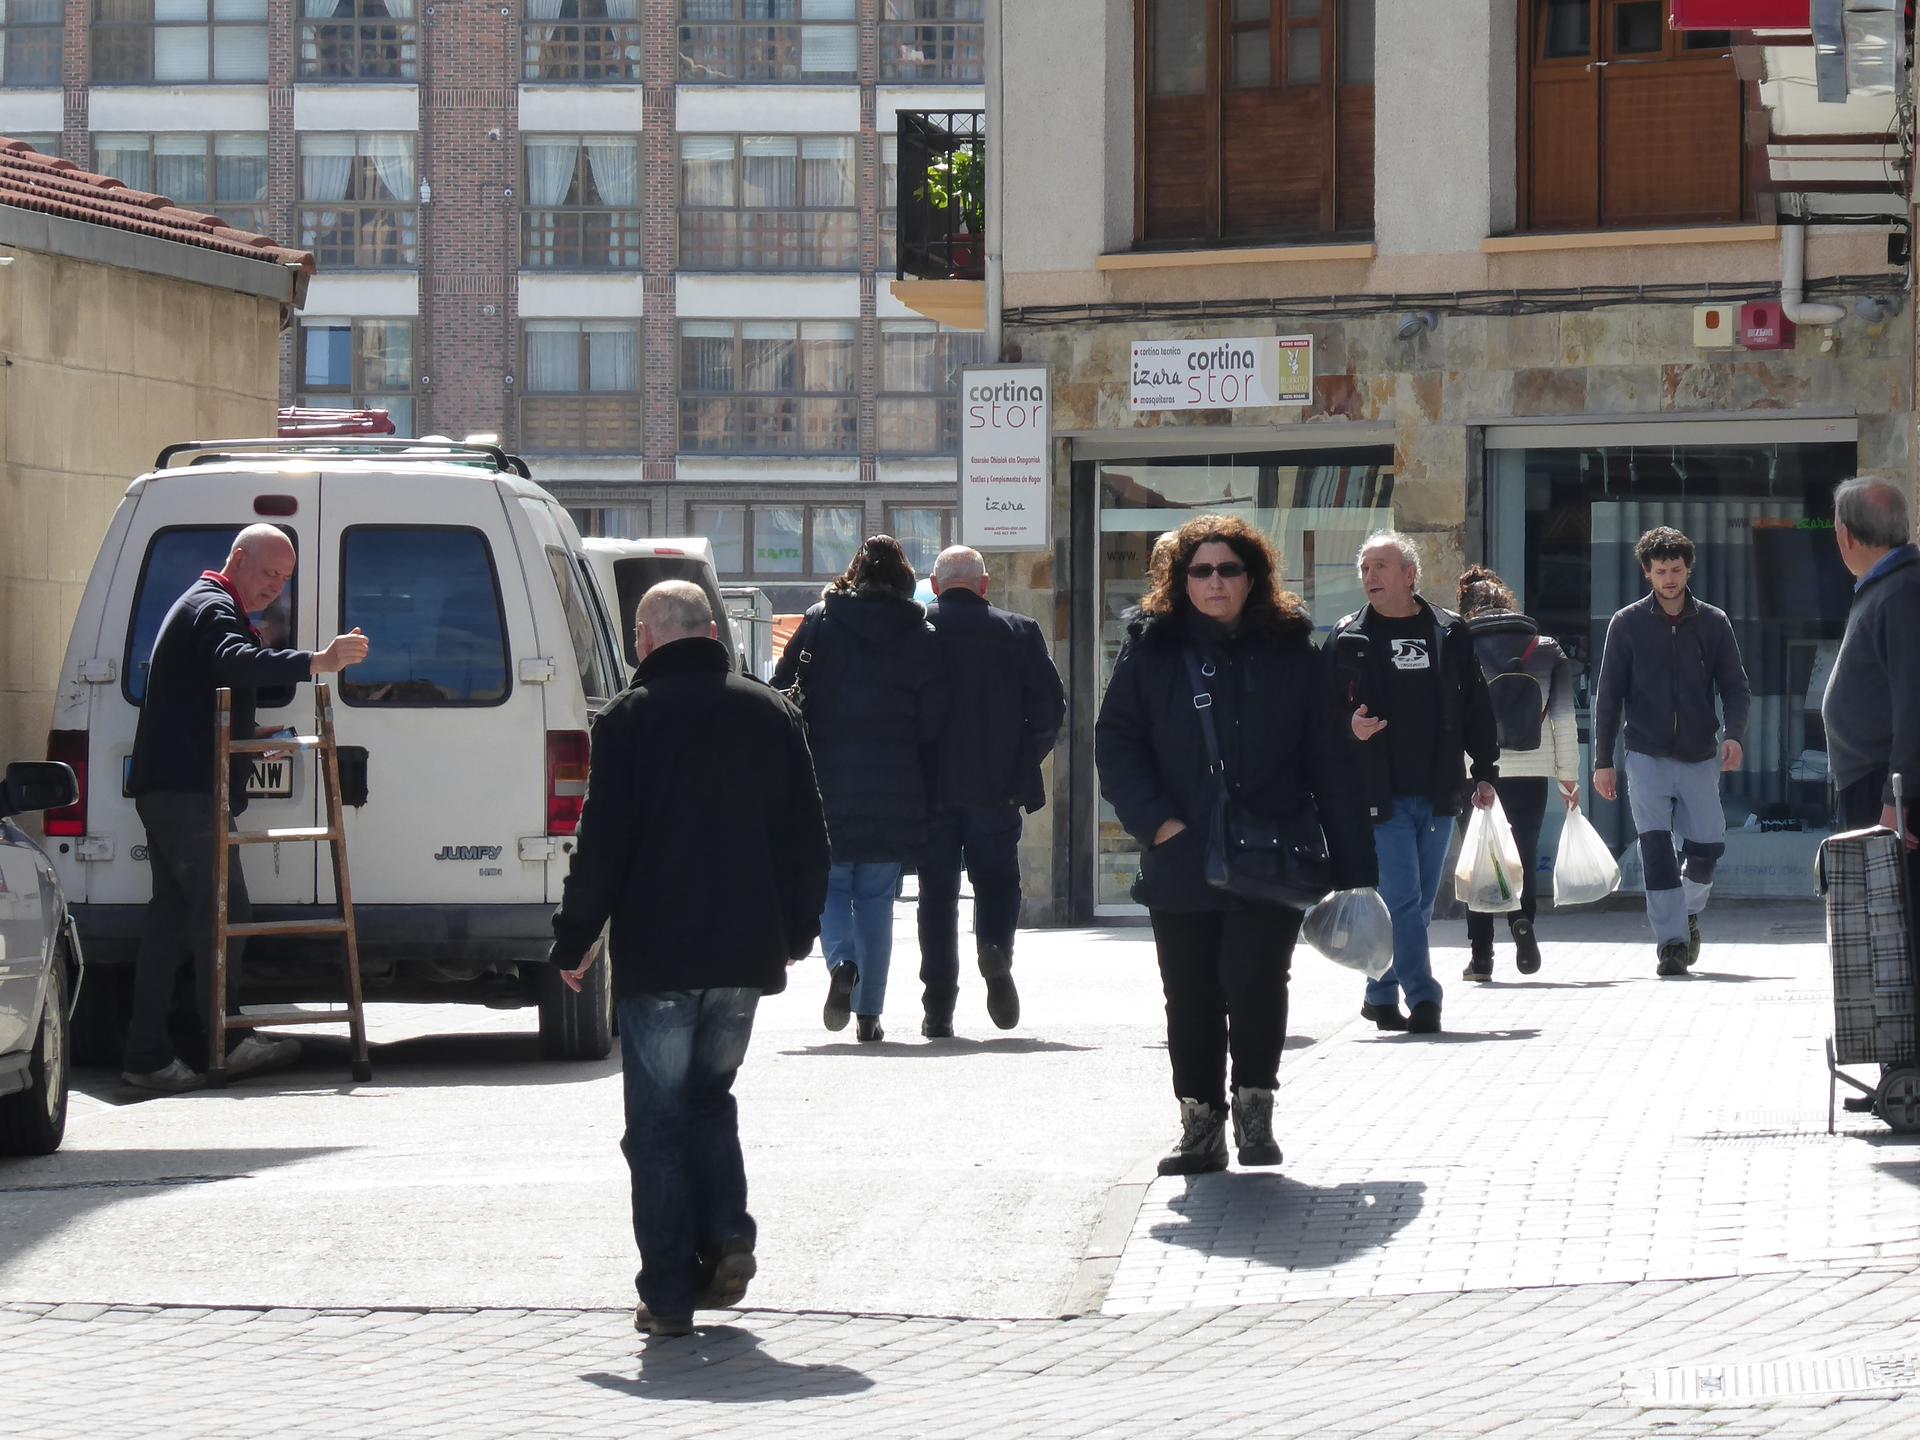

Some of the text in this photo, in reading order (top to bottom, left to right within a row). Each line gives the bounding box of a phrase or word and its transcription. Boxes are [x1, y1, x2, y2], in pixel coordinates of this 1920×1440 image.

[1140, 346, 1160, 356] cortina
[1187, 343, 1255, 370] cortina
[1133, 362, 1183, 388] izara
[1187, 368, 1255, 404] stor
[969, 380, 1043, 402] cortina
[969, 400, 1043, 428] stor
[985, 497, 1025, 512] izara
[434, 845, 502, 860] JUMPY
